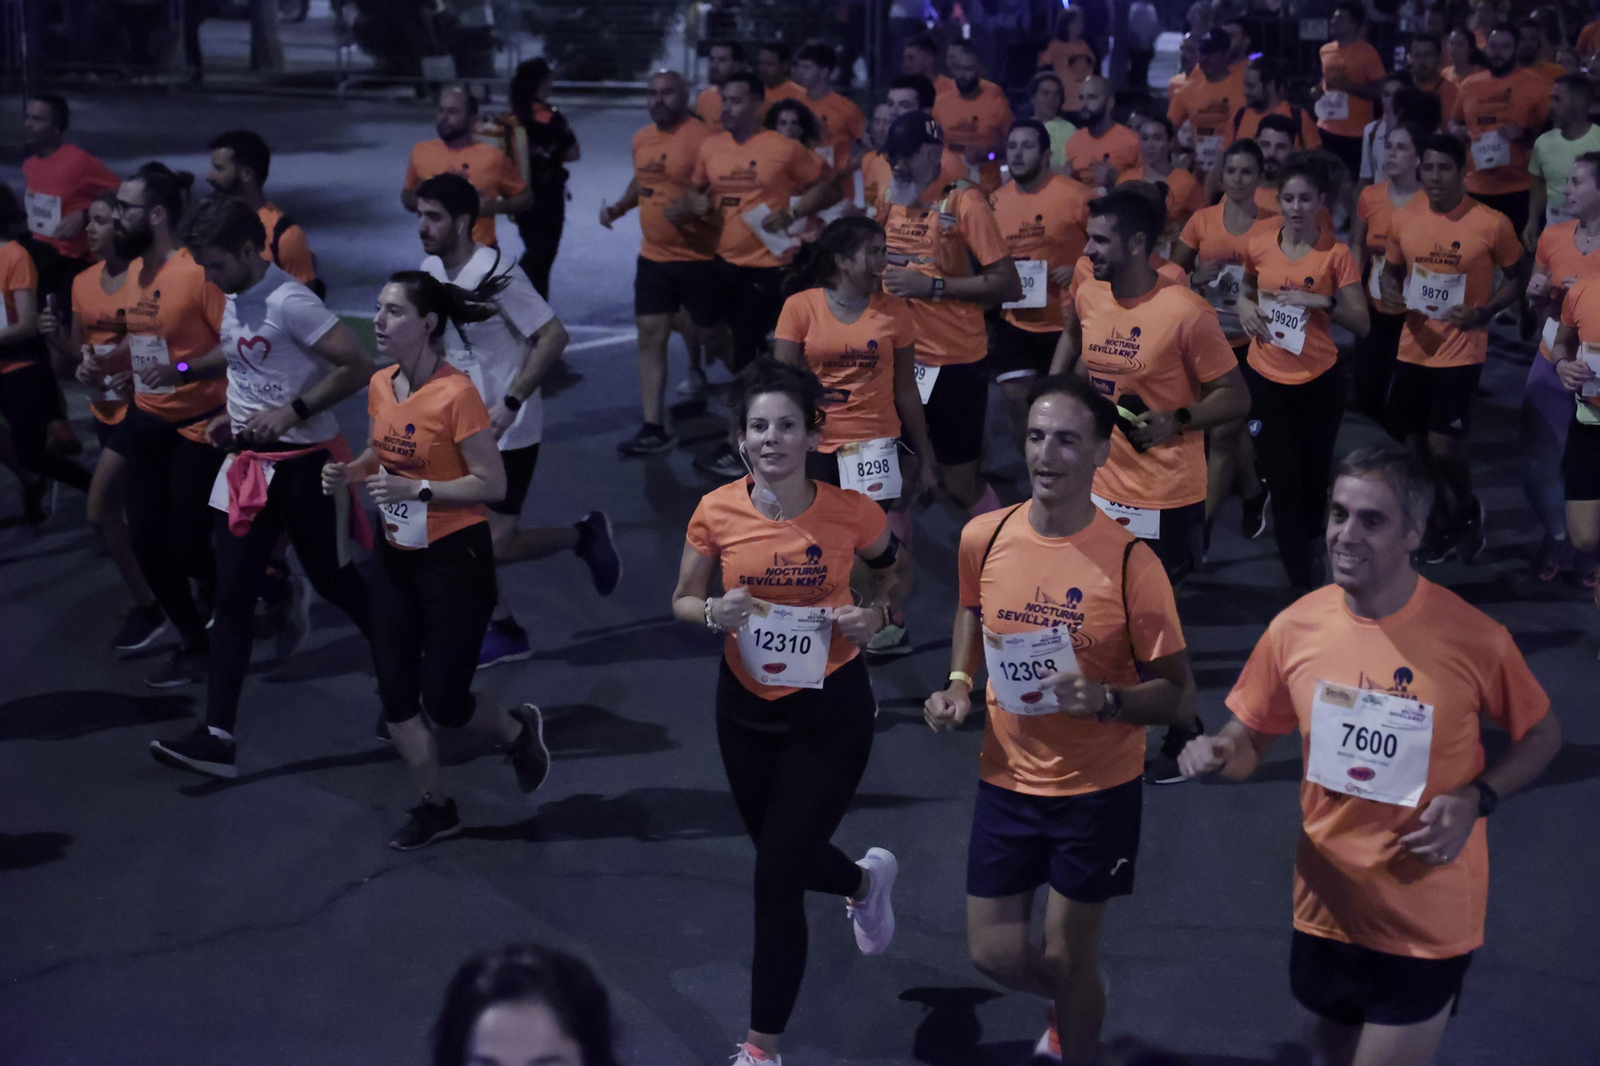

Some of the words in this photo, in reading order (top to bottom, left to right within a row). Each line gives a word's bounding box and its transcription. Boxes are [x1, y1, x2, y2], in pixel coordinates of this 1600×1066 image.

[1422, 285, 1449, 301] 9870
[1270, 308, 1299, 330] 19920
[1088, 343, 1118, 355] SEVILLA
[1104, 338, 1140, 352] NOCTURNA
[822, 360, 858, 368] SEVILLA
[383, 435, 417, 449] NOCTURNA
[857, 458, 890, 477] 8298
[765, 565, 828, 577] NOCTURNA
[739, 574, 793, 587] SEVILLA
[795, 574, 828, 587] KH7
[996, 608, 1050, 627] SEVILLA
[1024, 602, 1085, 622] NOCTURNA
[753, 628, 812, 655] 12310
[1342, 722, 1398, 759] 7600
